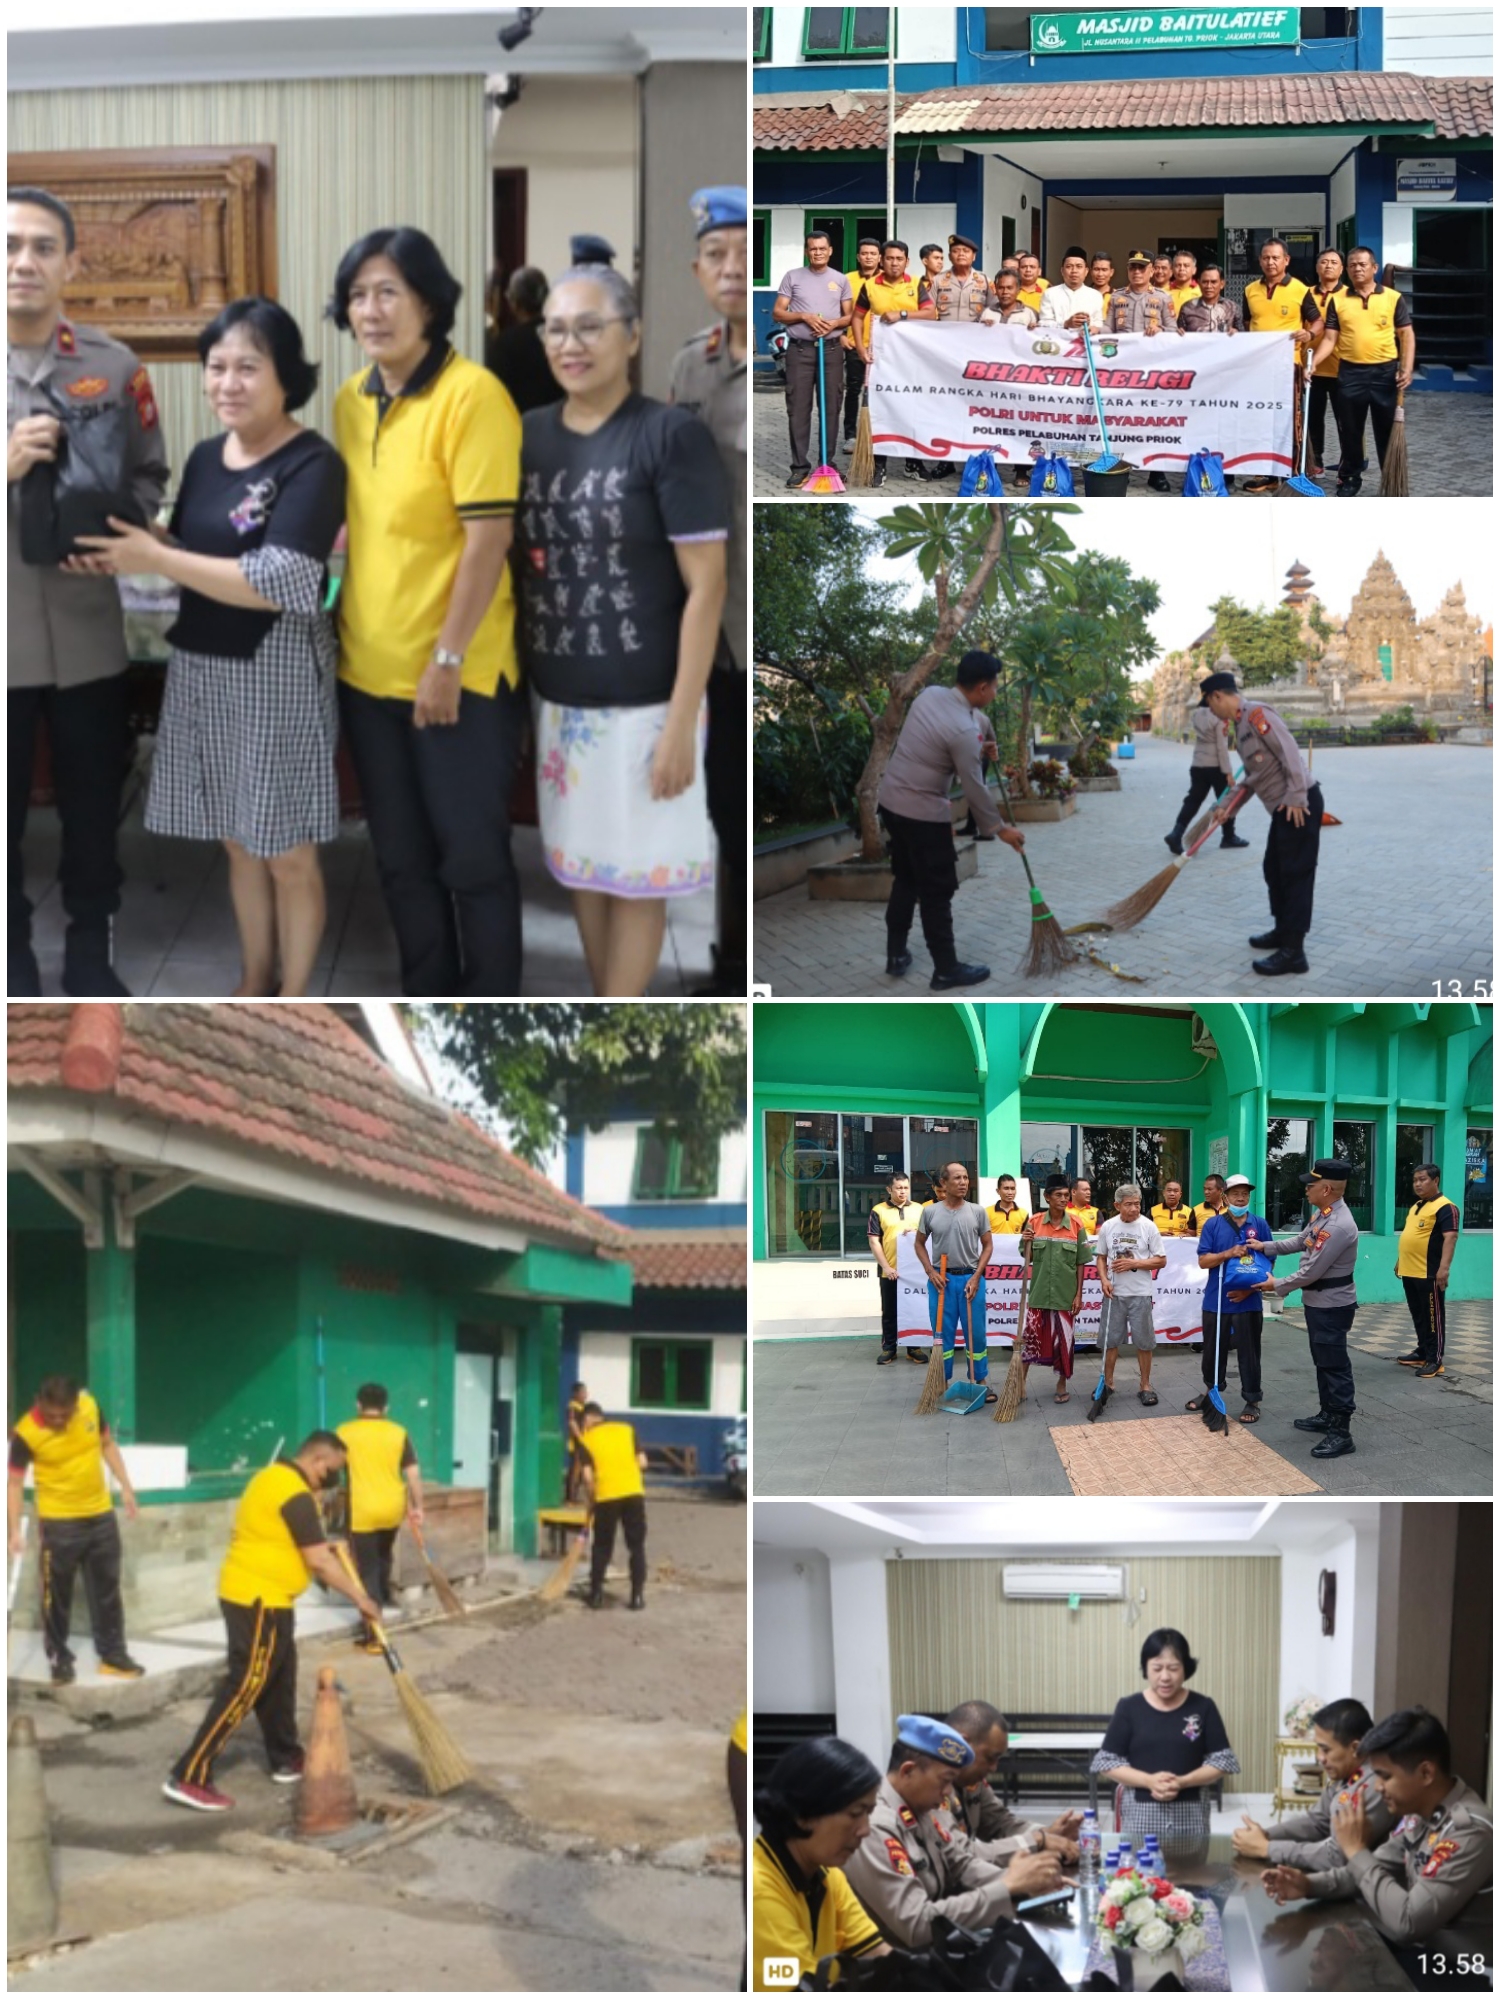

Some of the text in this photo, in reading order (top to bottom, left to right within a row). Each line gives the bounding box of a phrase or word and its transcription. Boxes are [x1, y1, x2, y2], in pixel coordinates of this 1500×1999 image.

[1076, 10, 1288, 34] MASJID BAITULATIEF
[1142, 36, 1183, 45] PELABUHAN
[1196, 34, 1218, 42] PRIOK
[1224, 32, 1256, 41] JAKARTA
[1257, 31, 1280, 39] UTARA
[963, 361, 1196, 390] BHAKTI RELIGI
[875, 384, 923, 393] DALAM
[929, 387, 984, 398] RANGKA
[990, 391, 1022, 400] HARI
[1141, 399, 1183, 408] KE-79
[1190, 399, 1239, 409] TAHUN
[1246, 401, 1283, 410] 2025
[968, 405, 1188, 427] POLRI UNTUK MASYARAKAT
[973, 426, 1016, 436] POLRES
[1018, 429, 1086, 441] PELABUHAN
[1146, 435, 1182, 444] PRIOK
[832, 1269, 869, 1279] BATAS SUCI
[985, 1264, 1033, 1280] BHA
[985, 1302, 1020, 1311] POLR
[988, 1317, 1019, 1325] POLRE
